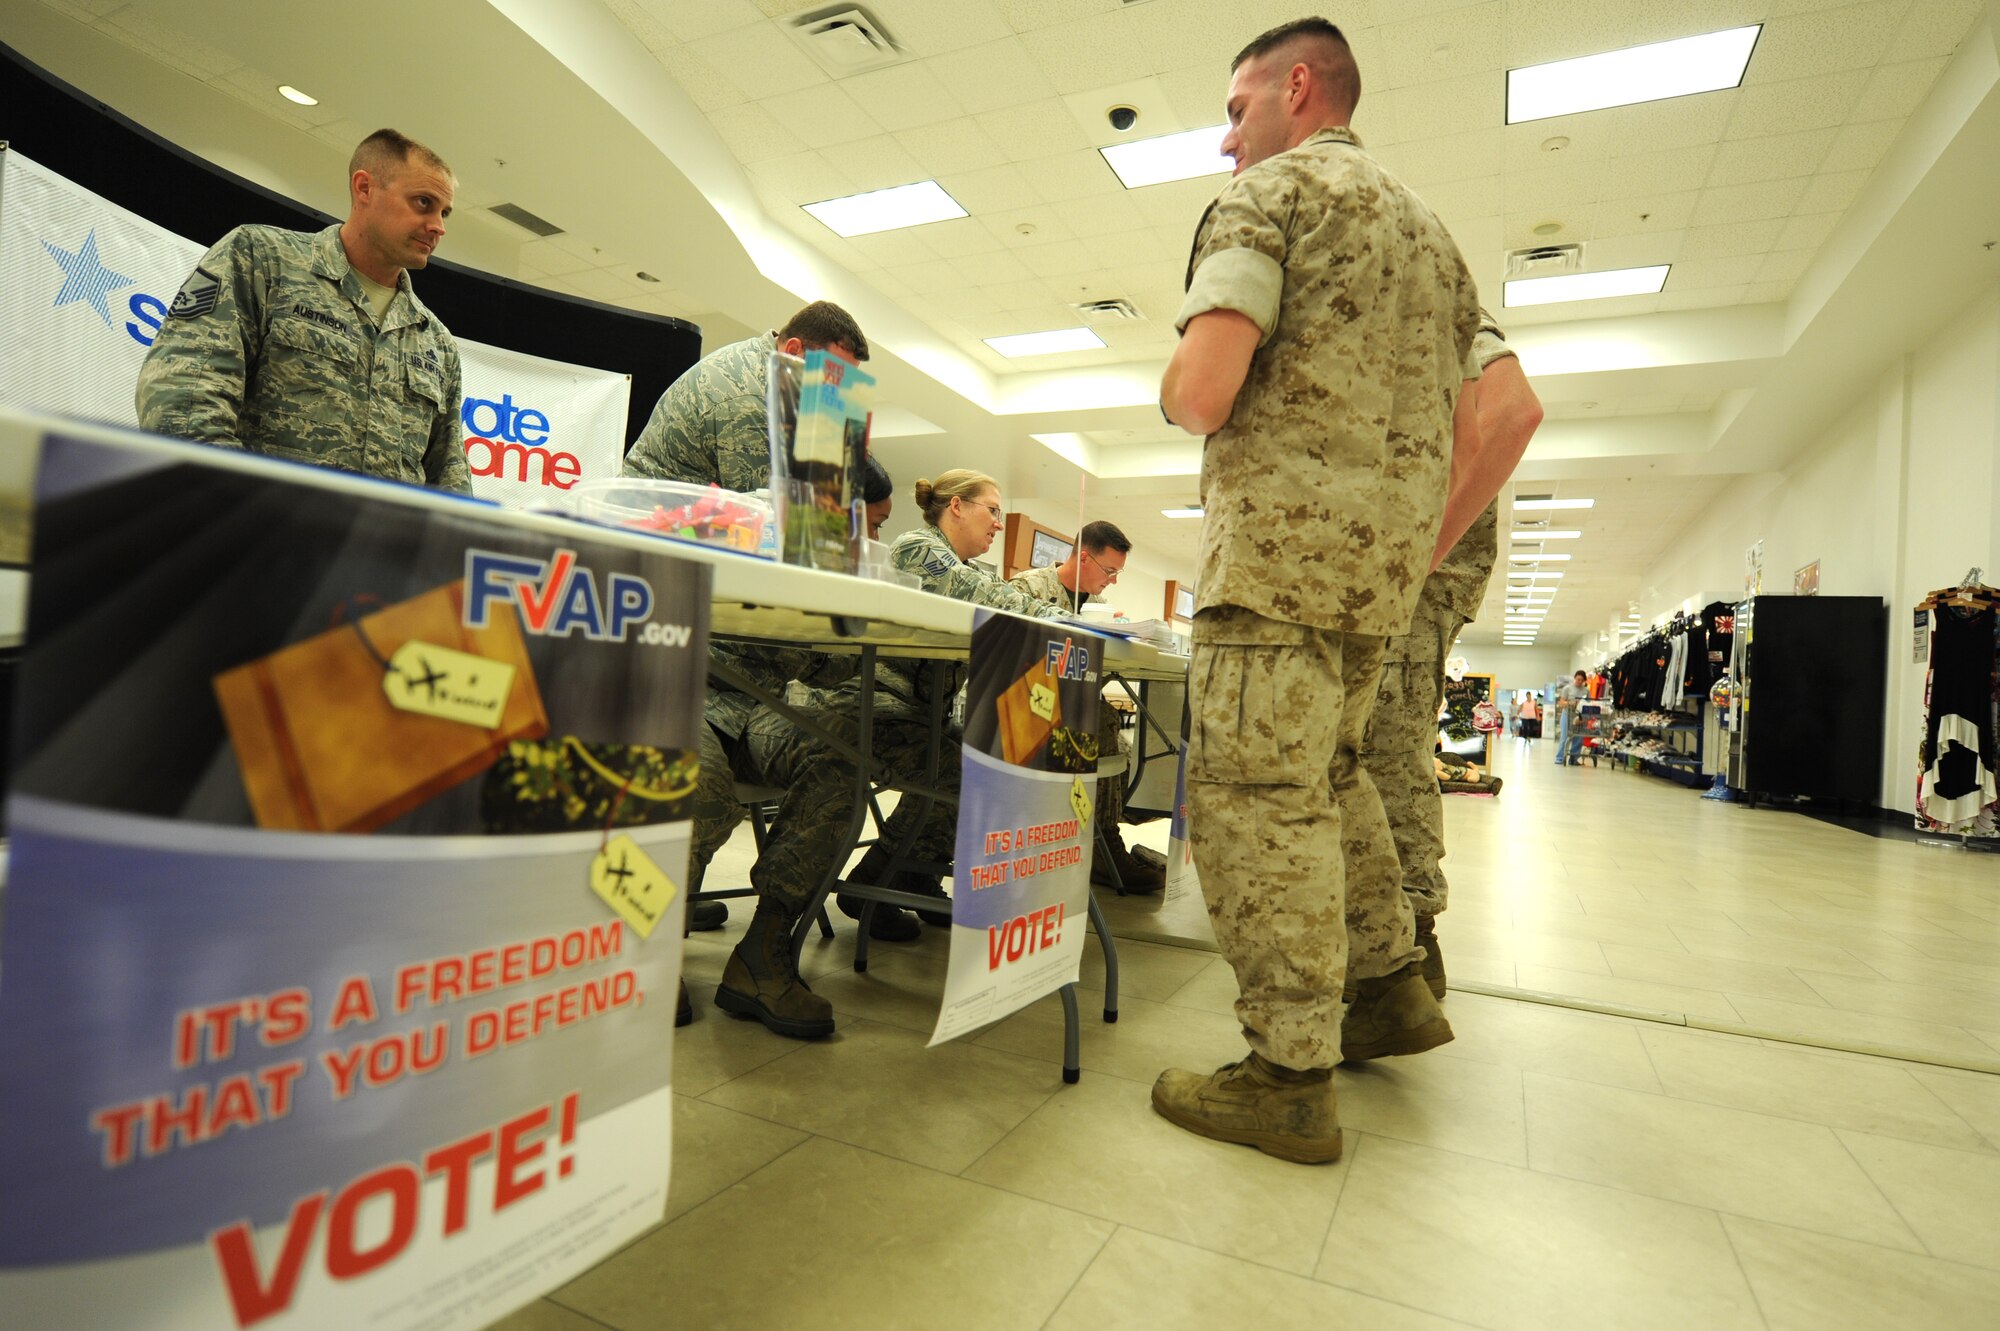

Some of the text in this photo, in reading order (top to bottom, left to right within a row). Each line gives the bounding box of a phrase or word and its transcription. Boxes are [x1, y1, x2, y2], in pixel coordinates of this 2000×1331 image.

[292, 303, 348, 333] AUSTINSON
[970, 862, 1009, 890] THAT
[1012, 854, 1037, 880] YOU
[984, 819, 1079, 856] IT'S A FREEDOM
[988, 902, 1065, 972] VOTE!
[174, 919, 624, 1068] IT'S A FREEDOM
[94, 968, 645, 1167] THAT YOU DEFEND,
[210, 1090, 582, 1330] VOTE!
